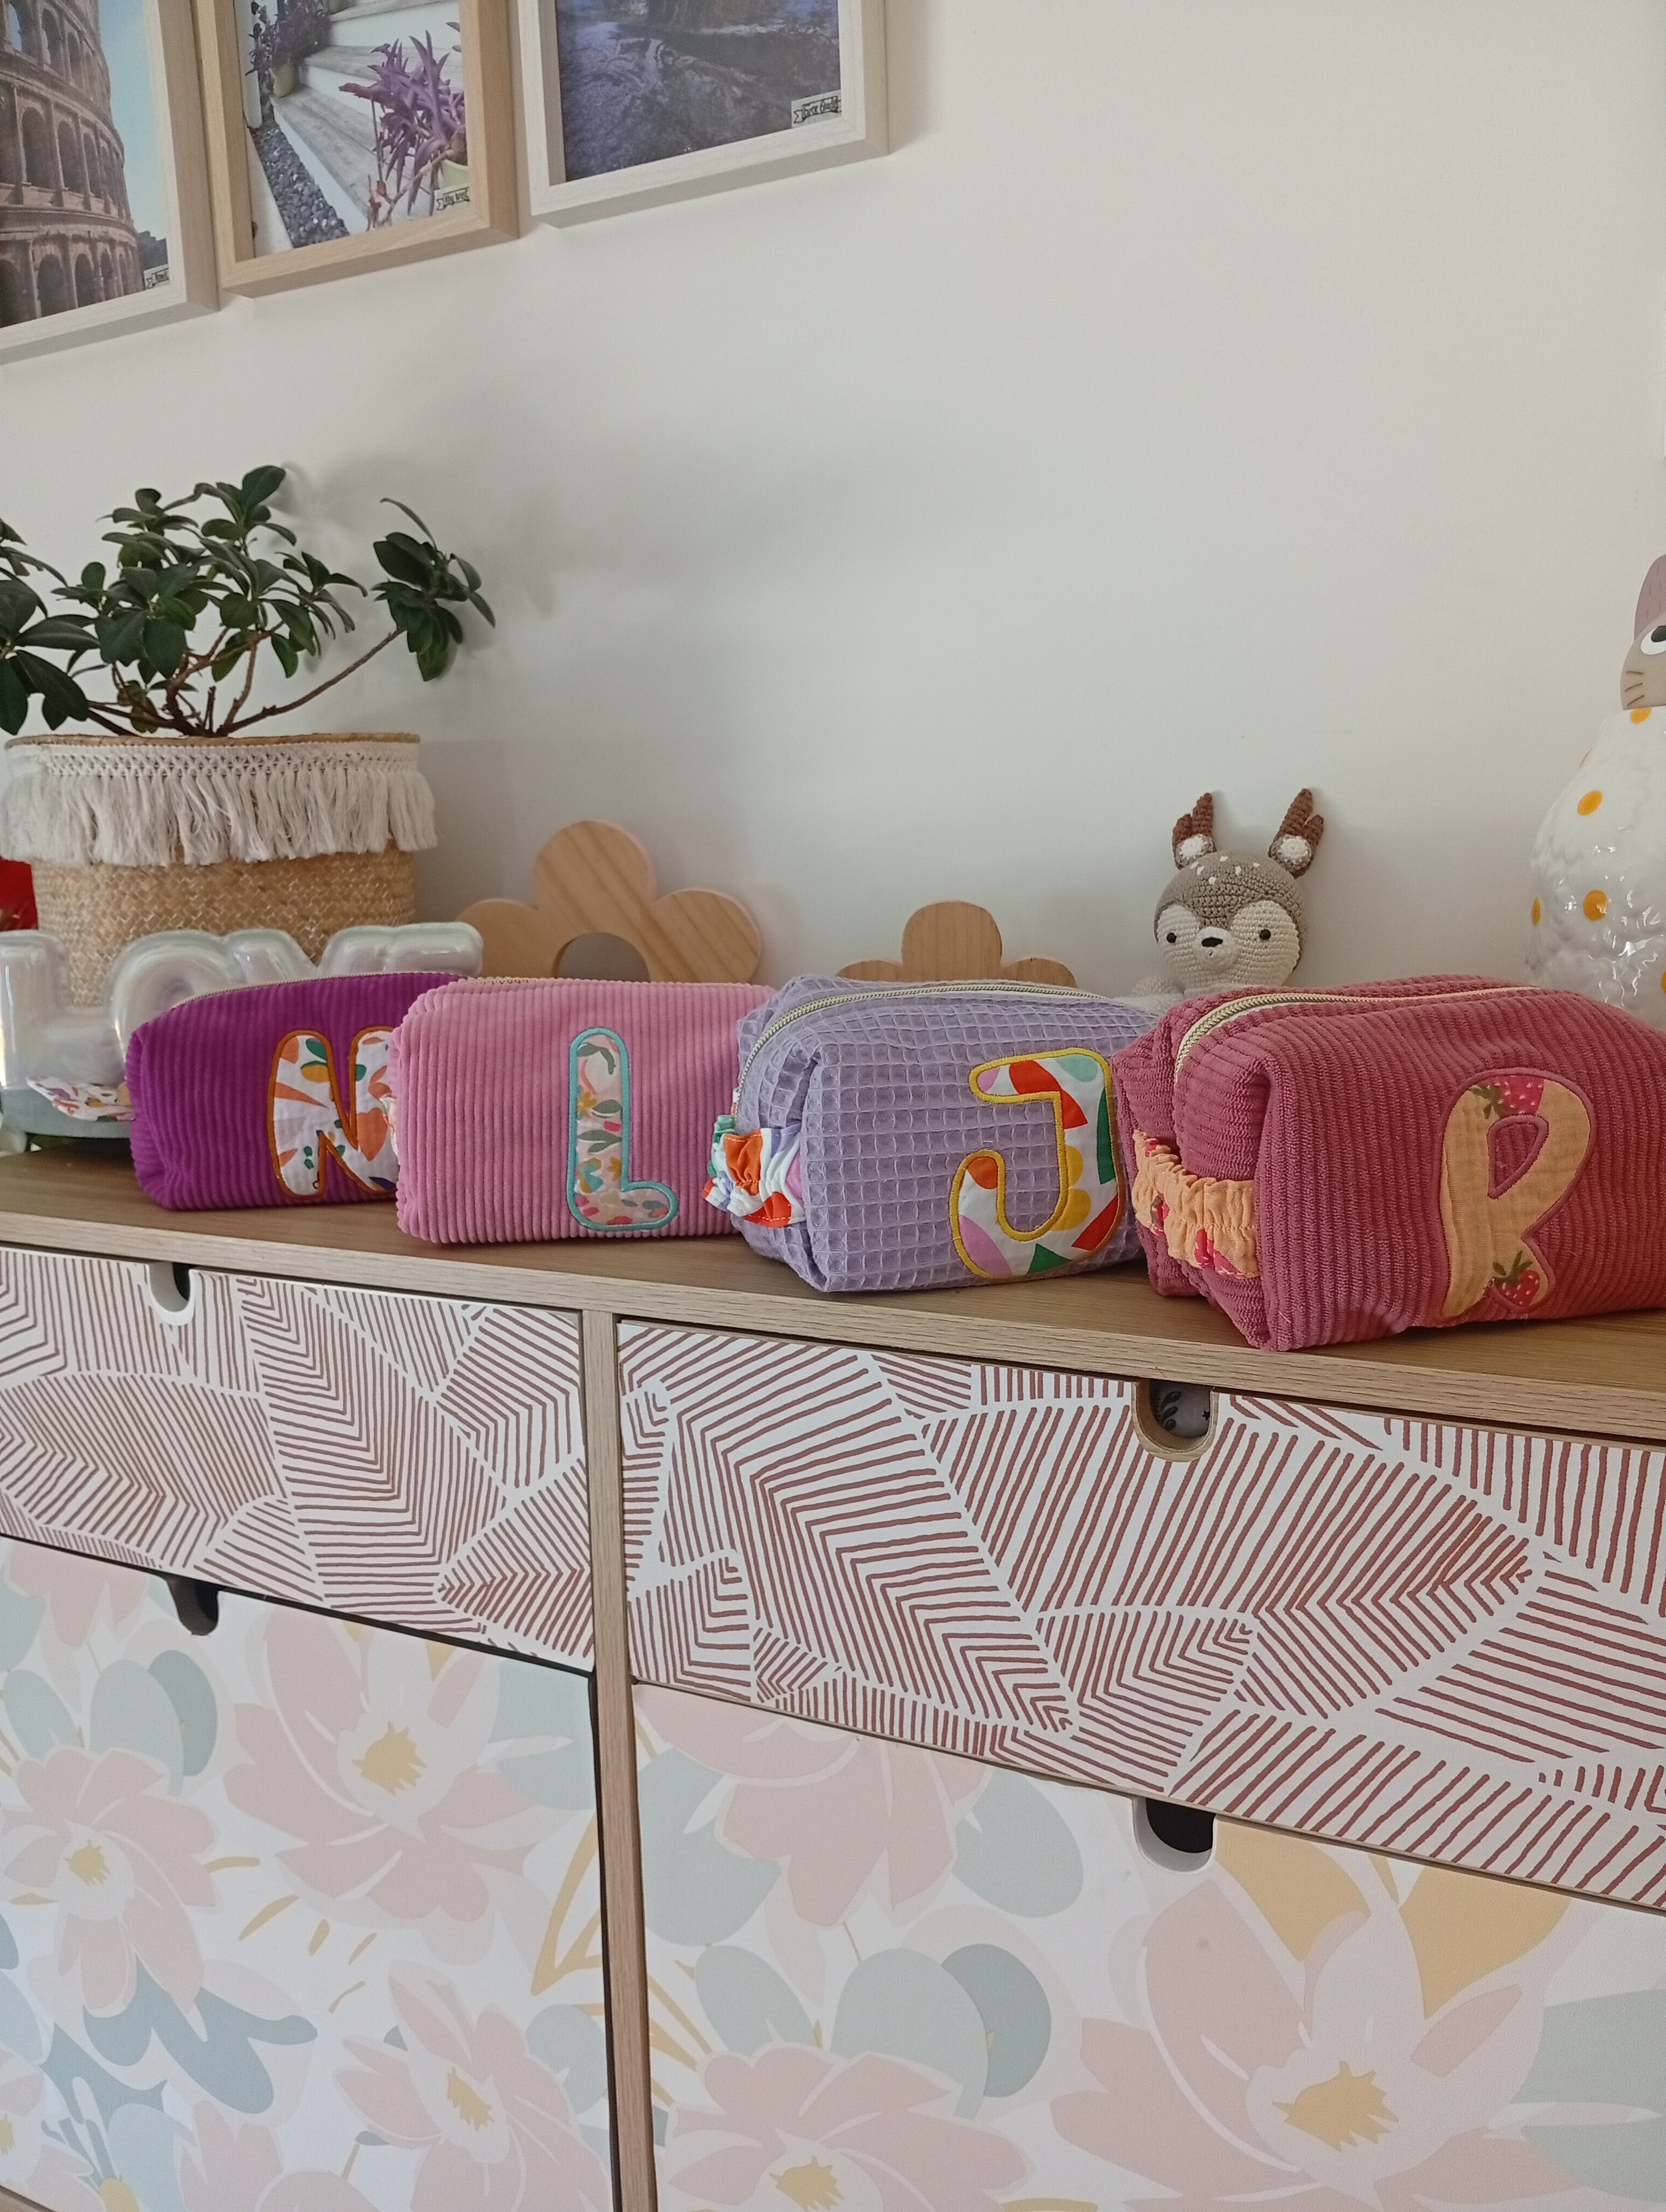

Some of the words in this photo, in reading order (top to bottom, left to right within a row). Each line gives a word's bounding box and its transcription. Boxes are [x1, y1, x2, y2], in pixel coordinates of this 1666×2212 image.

[267, 1026, 399, 1199] N
[566, 1027, 678, 1231] L
[949, 1047, 1126, 1279] J
[1436, 1068, 1596, 1324] R
